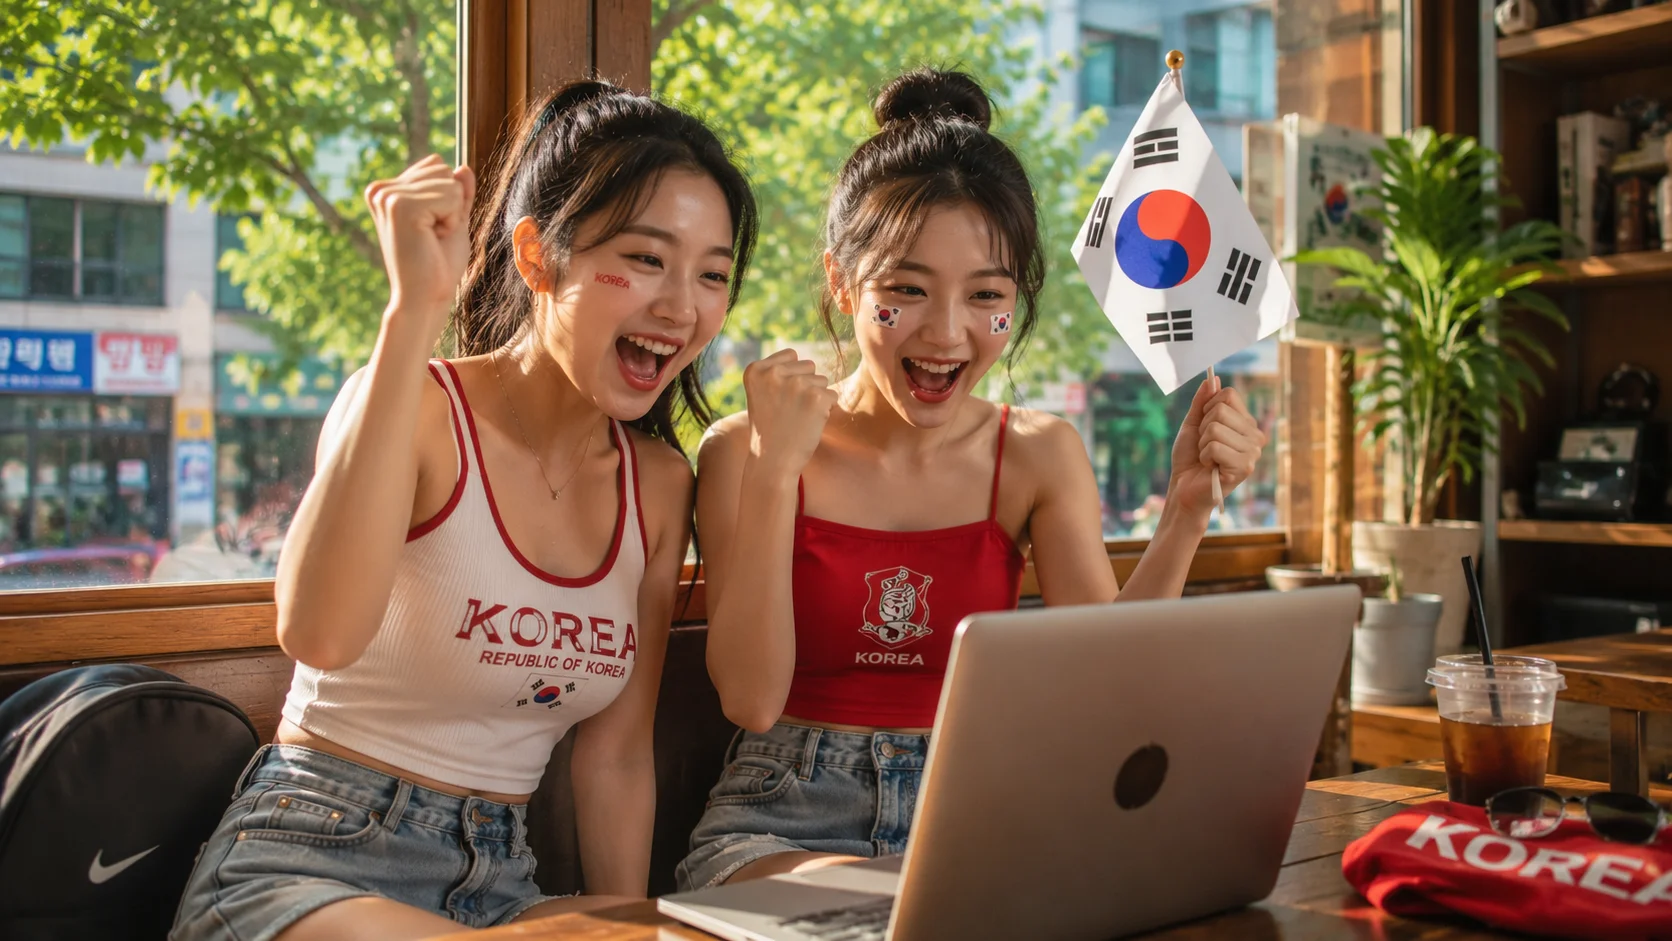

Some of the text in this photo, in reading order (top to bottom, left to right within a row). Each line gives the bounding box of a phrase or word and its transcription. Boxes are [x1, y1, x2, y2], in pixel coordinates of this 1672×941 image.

[455, 598, 636, 661] KOREA
[479, 650, 626, 679] REPUBLIC OF KOREA
[855, 652, 924, 665] KOREA
